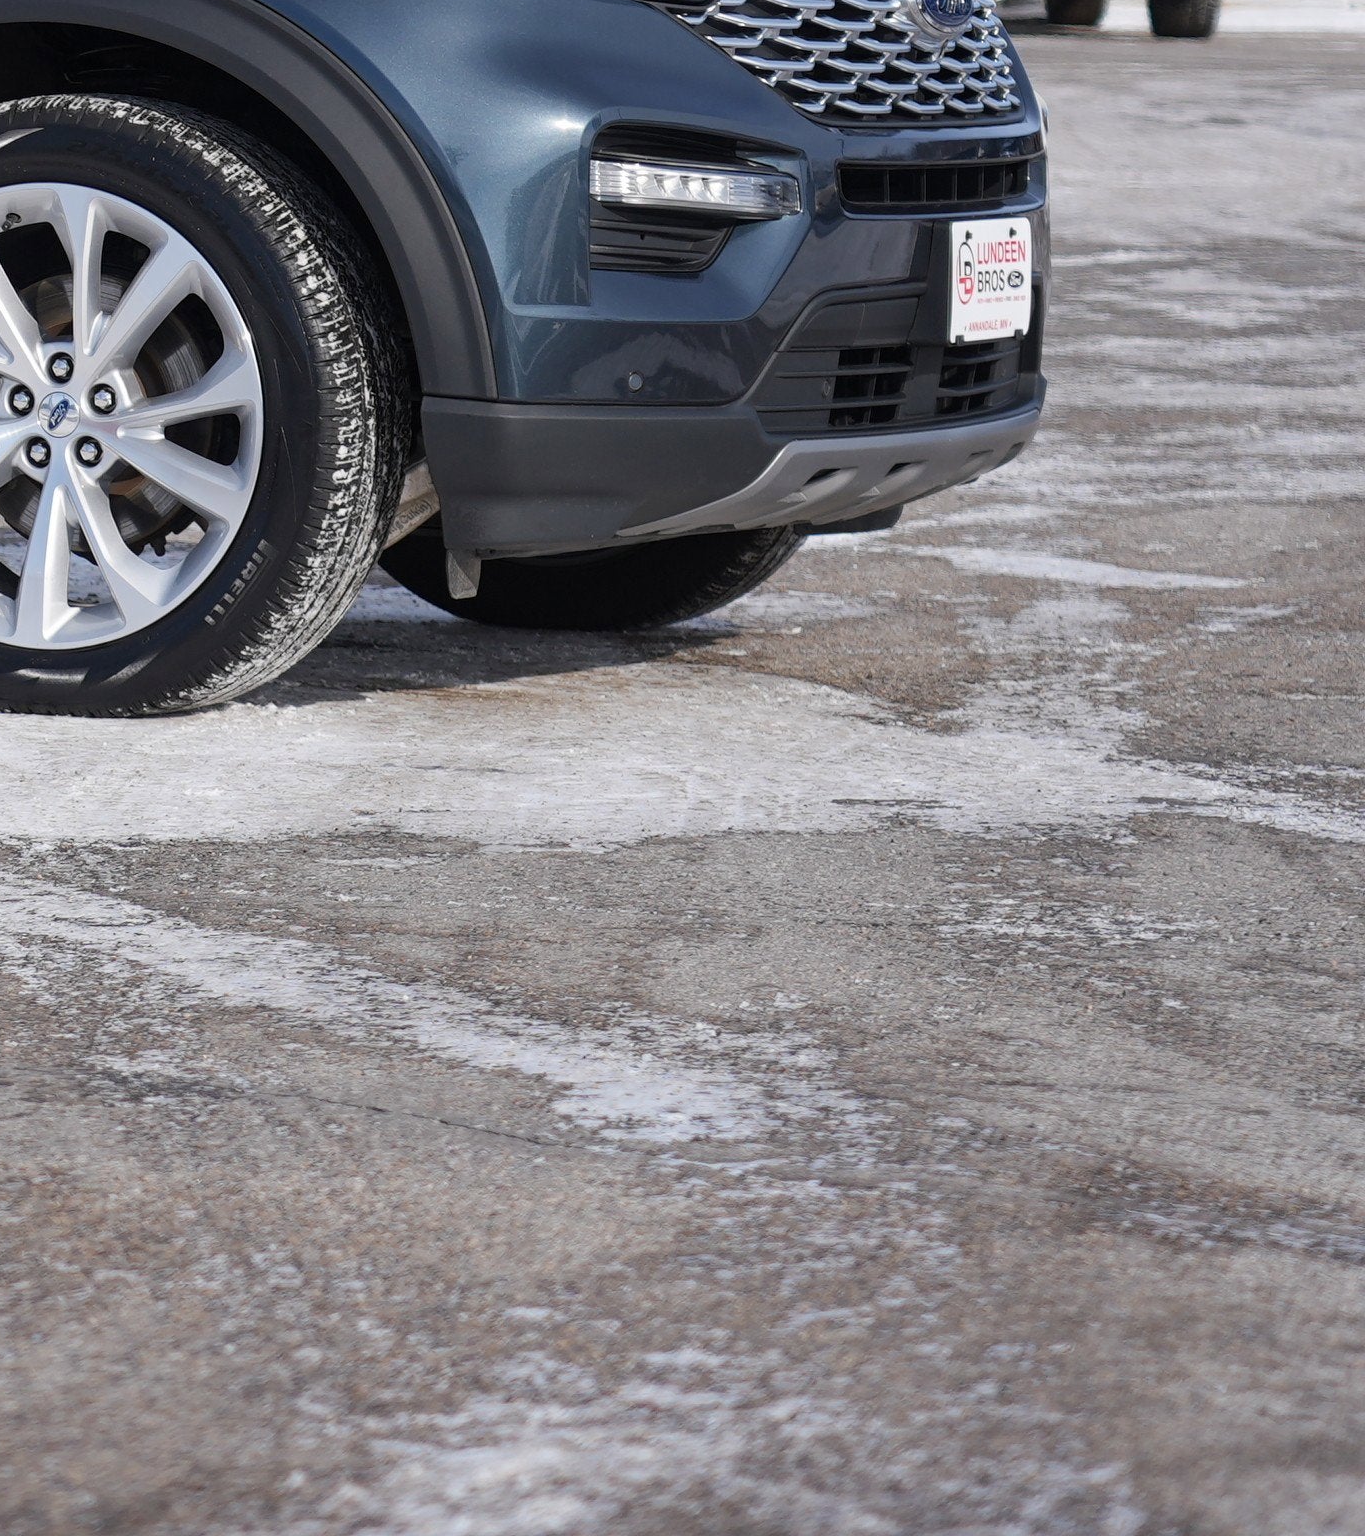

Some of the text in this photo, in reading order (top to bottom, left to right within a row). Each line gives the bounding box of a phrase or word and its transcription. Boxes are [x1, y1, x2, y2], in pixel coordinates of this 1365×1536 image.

[977, 241, 1026, 264] LUNDEEN
[977, 269, 1005, 293] BROS
[1000, 318, 1009, 329] MN
[204, 538, 275, 626] PIRELLI
